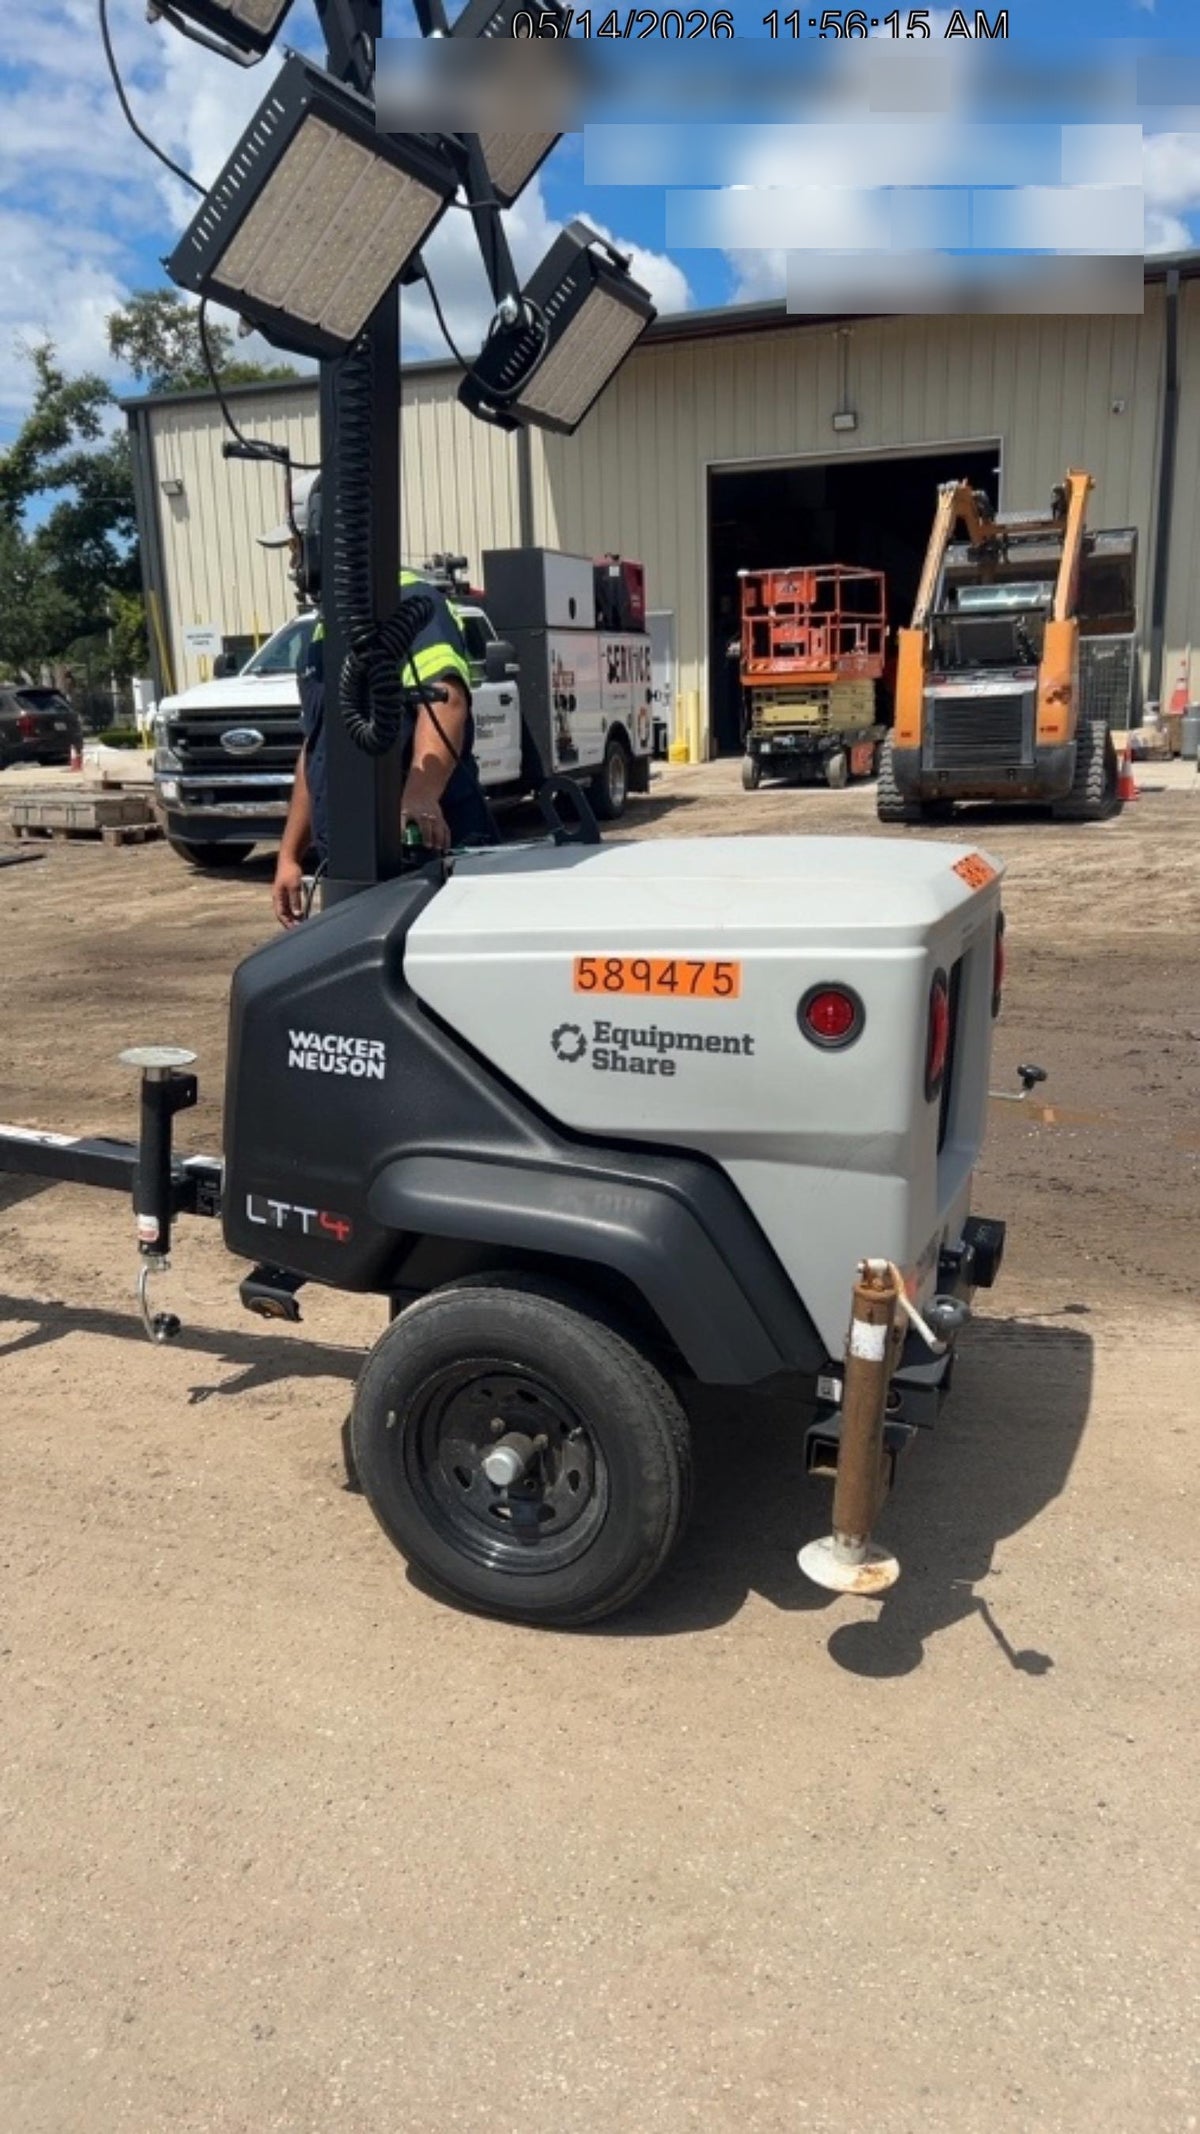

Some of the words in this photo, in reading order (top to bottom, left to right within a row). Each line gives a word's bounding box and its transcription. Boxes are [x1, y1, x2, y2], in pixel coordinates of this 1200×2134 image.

[578, 957, 735, 996] 589475
[289, 1029, 385, 1060] WACKER
[593, 1020, 755, 1055] Equipment
[289, 1050, 385, 1080] NEUSON
[592, 1047, 676, 1076] Share
[246, 1193, 350, 1241] LTT4
